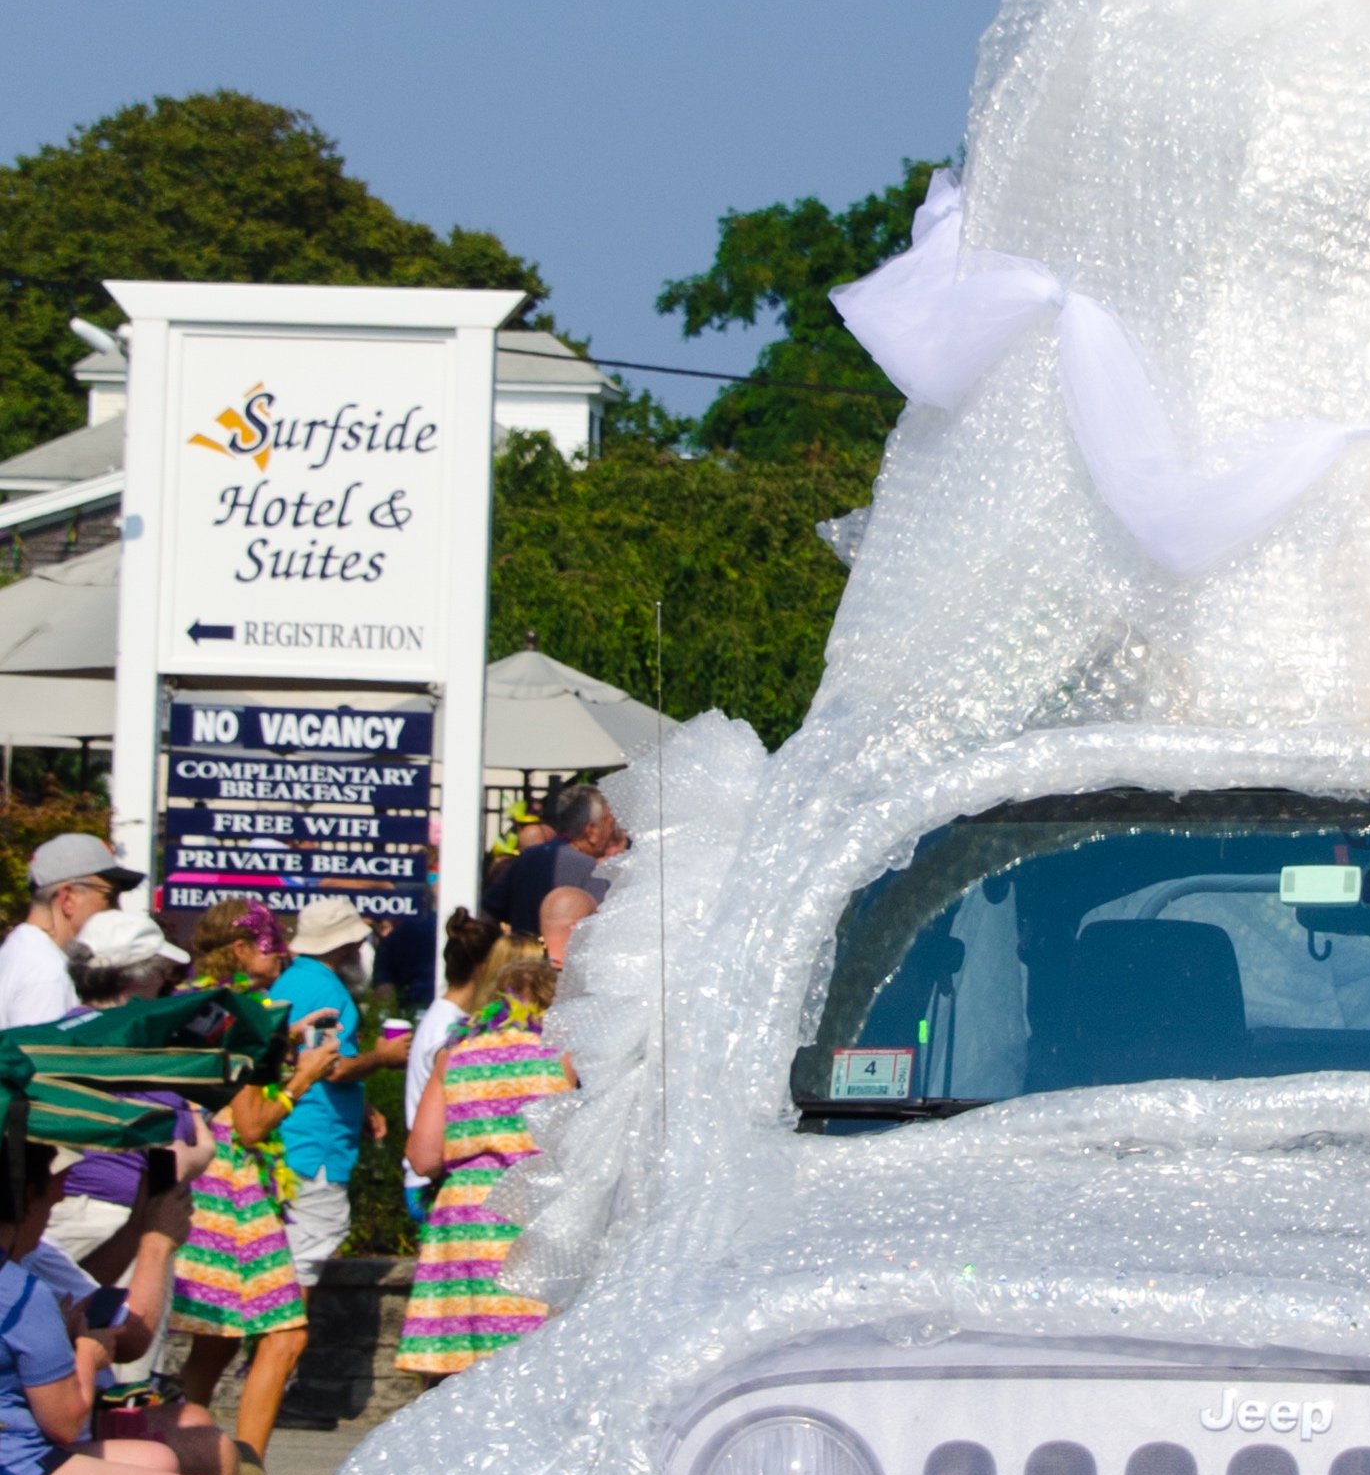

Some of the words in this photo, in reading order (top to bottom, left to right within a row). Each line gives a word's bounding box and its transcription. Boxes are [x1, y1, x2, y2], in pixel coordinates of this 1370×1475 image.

[229, 392, 437, 469] Surfside
[213, 480, 363, 528] Hotel
[369, 489, 413, 532] &
[235, 538, 387, 583] Suites
[244, 621, 424, 651] REGISTRATION
[192, 709, 240, 744] NO
[259, 712, 405, 750] VACANCY
[176, 760, 419, 787] COMPLIMENTARY
[219, 780, 377, 804] BREAKFAST
[213, 813, 294, 835] FREE
[303, 817, 381, 838] WIFI
[176, 849, 303, 873] PRIVATE
[311, 854, 414, 876] BEACH
[355, 895, 419, 915] POOL
[864, 1060, 877, 1076] 4
[1200, 1388, 1335, 1442] Jeep
